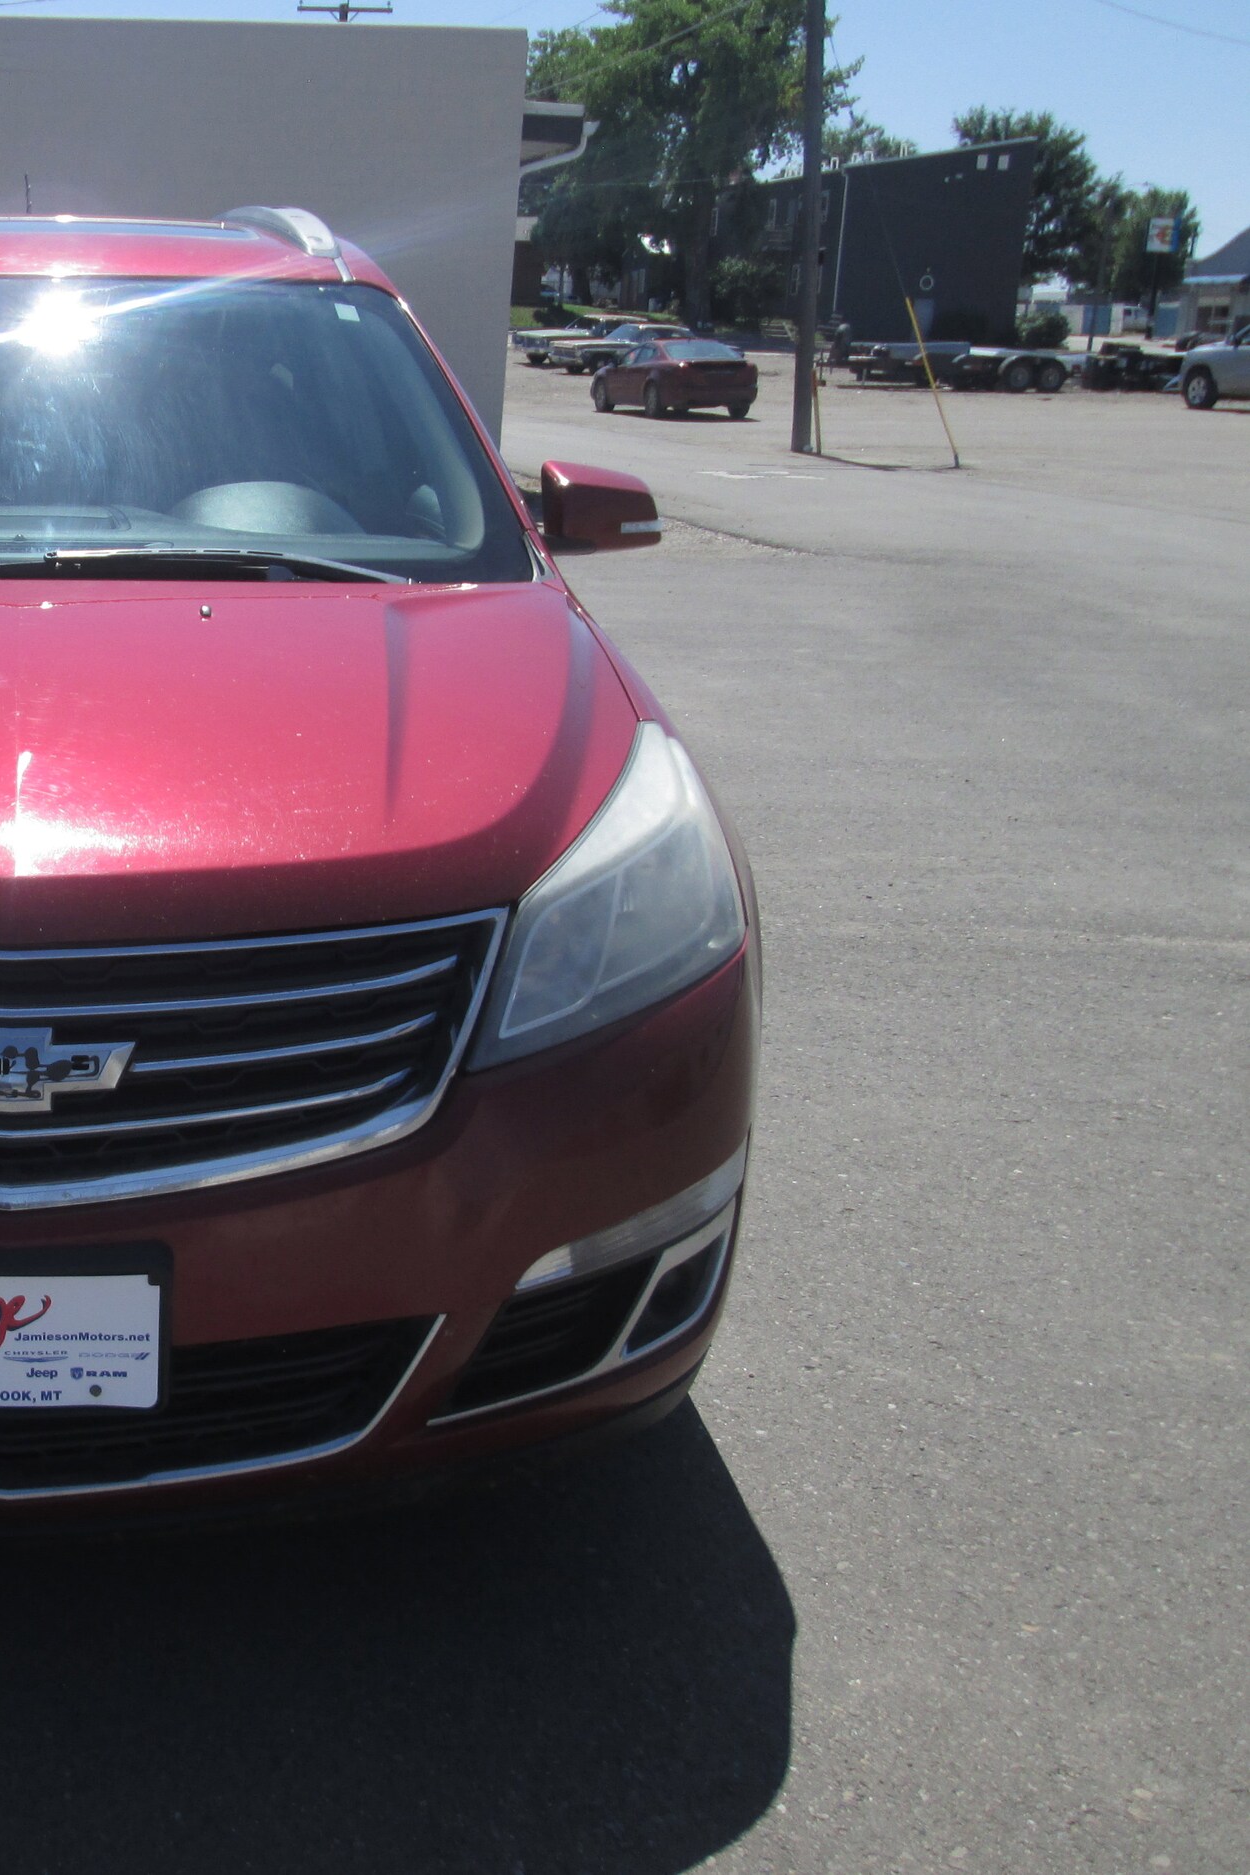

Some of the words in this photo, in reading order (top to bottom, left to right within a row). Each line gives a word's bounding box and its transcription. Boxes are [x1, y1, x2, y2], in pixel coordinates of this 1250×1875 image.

[14, 1332, 150, 1342] JamiesonMotors.net
[26, 1367, 58, 1379] Jeep
[85, 1370, 128, 1378] RAM
[40, 1391, 62, 1401] MT
